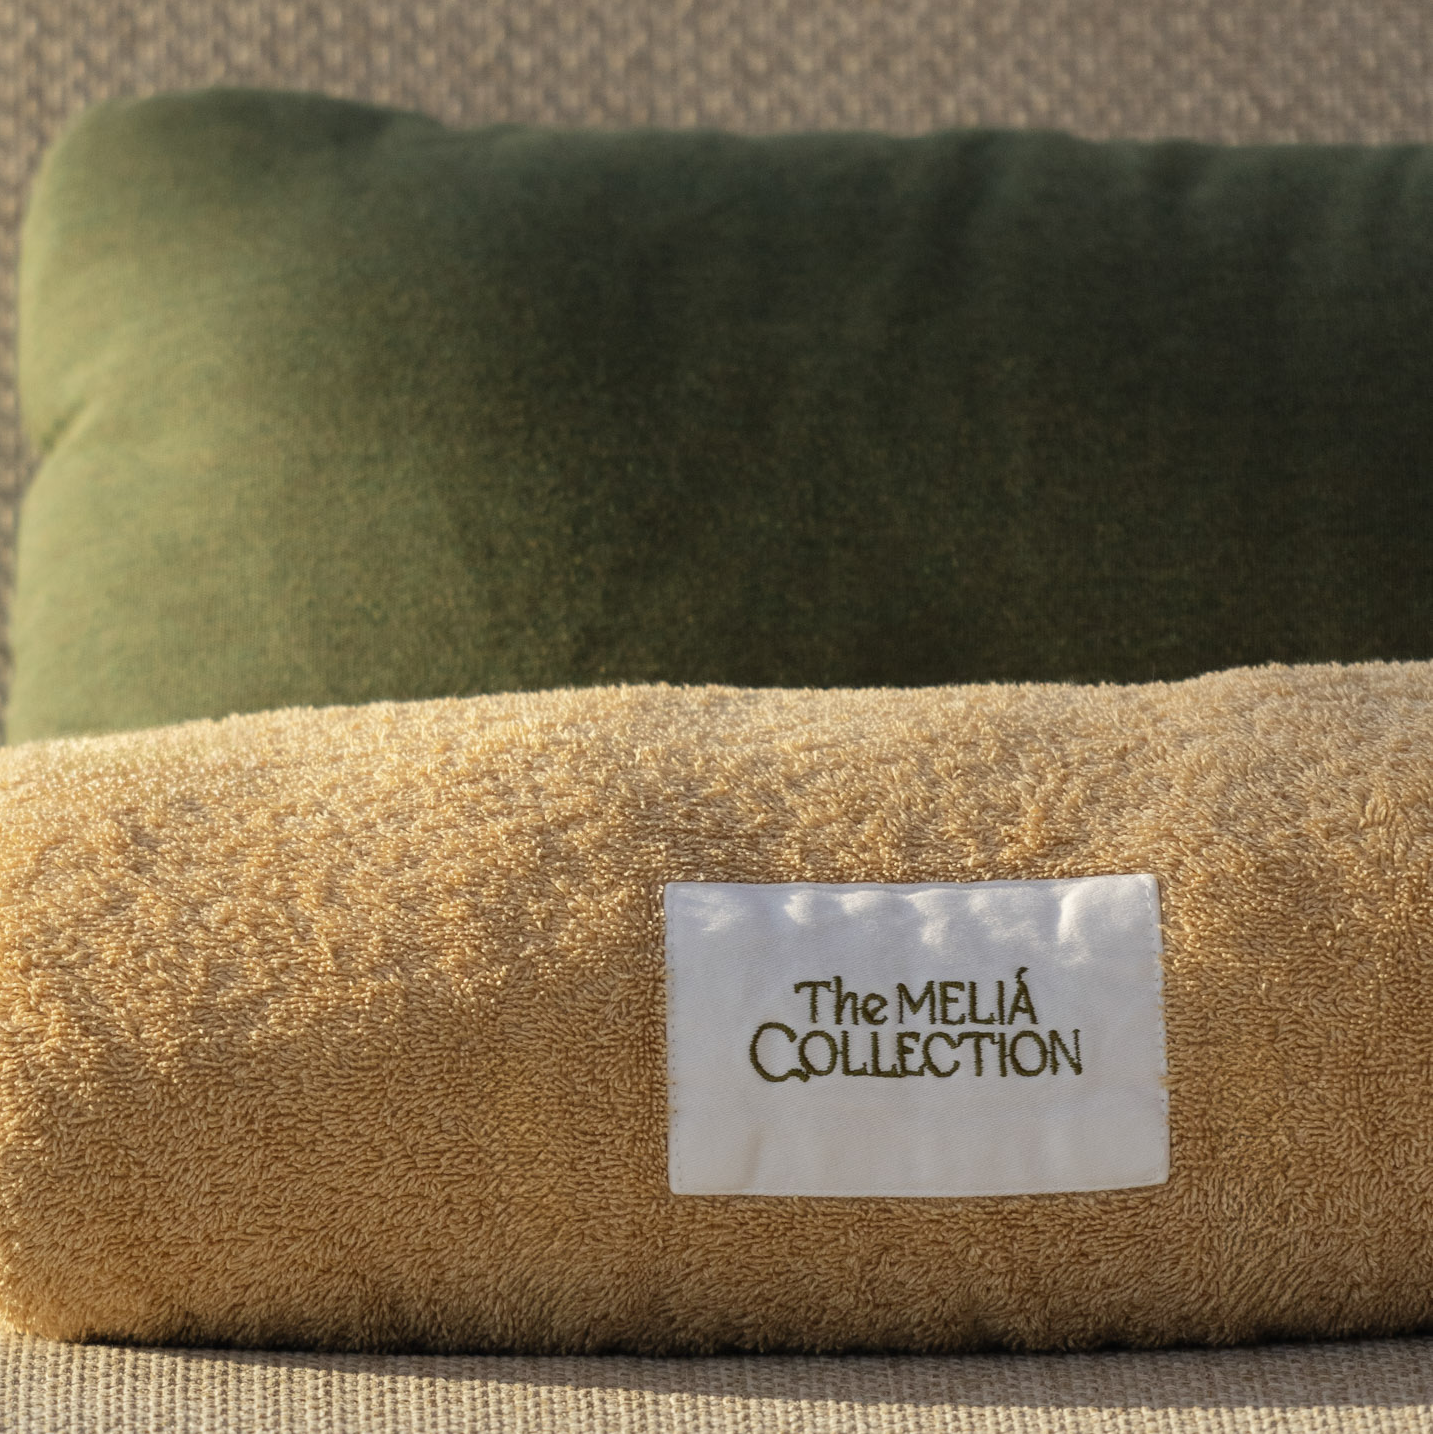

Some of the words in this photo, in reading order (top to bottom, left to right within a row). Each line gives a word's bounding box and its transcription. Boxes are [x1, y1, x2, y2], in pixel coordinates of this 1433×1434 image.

[793, 975, 889, 1026] The
[895, 966, 1040, 1026] MELIÁ
[748, 1021, 1084, 1084] COLLECTION
